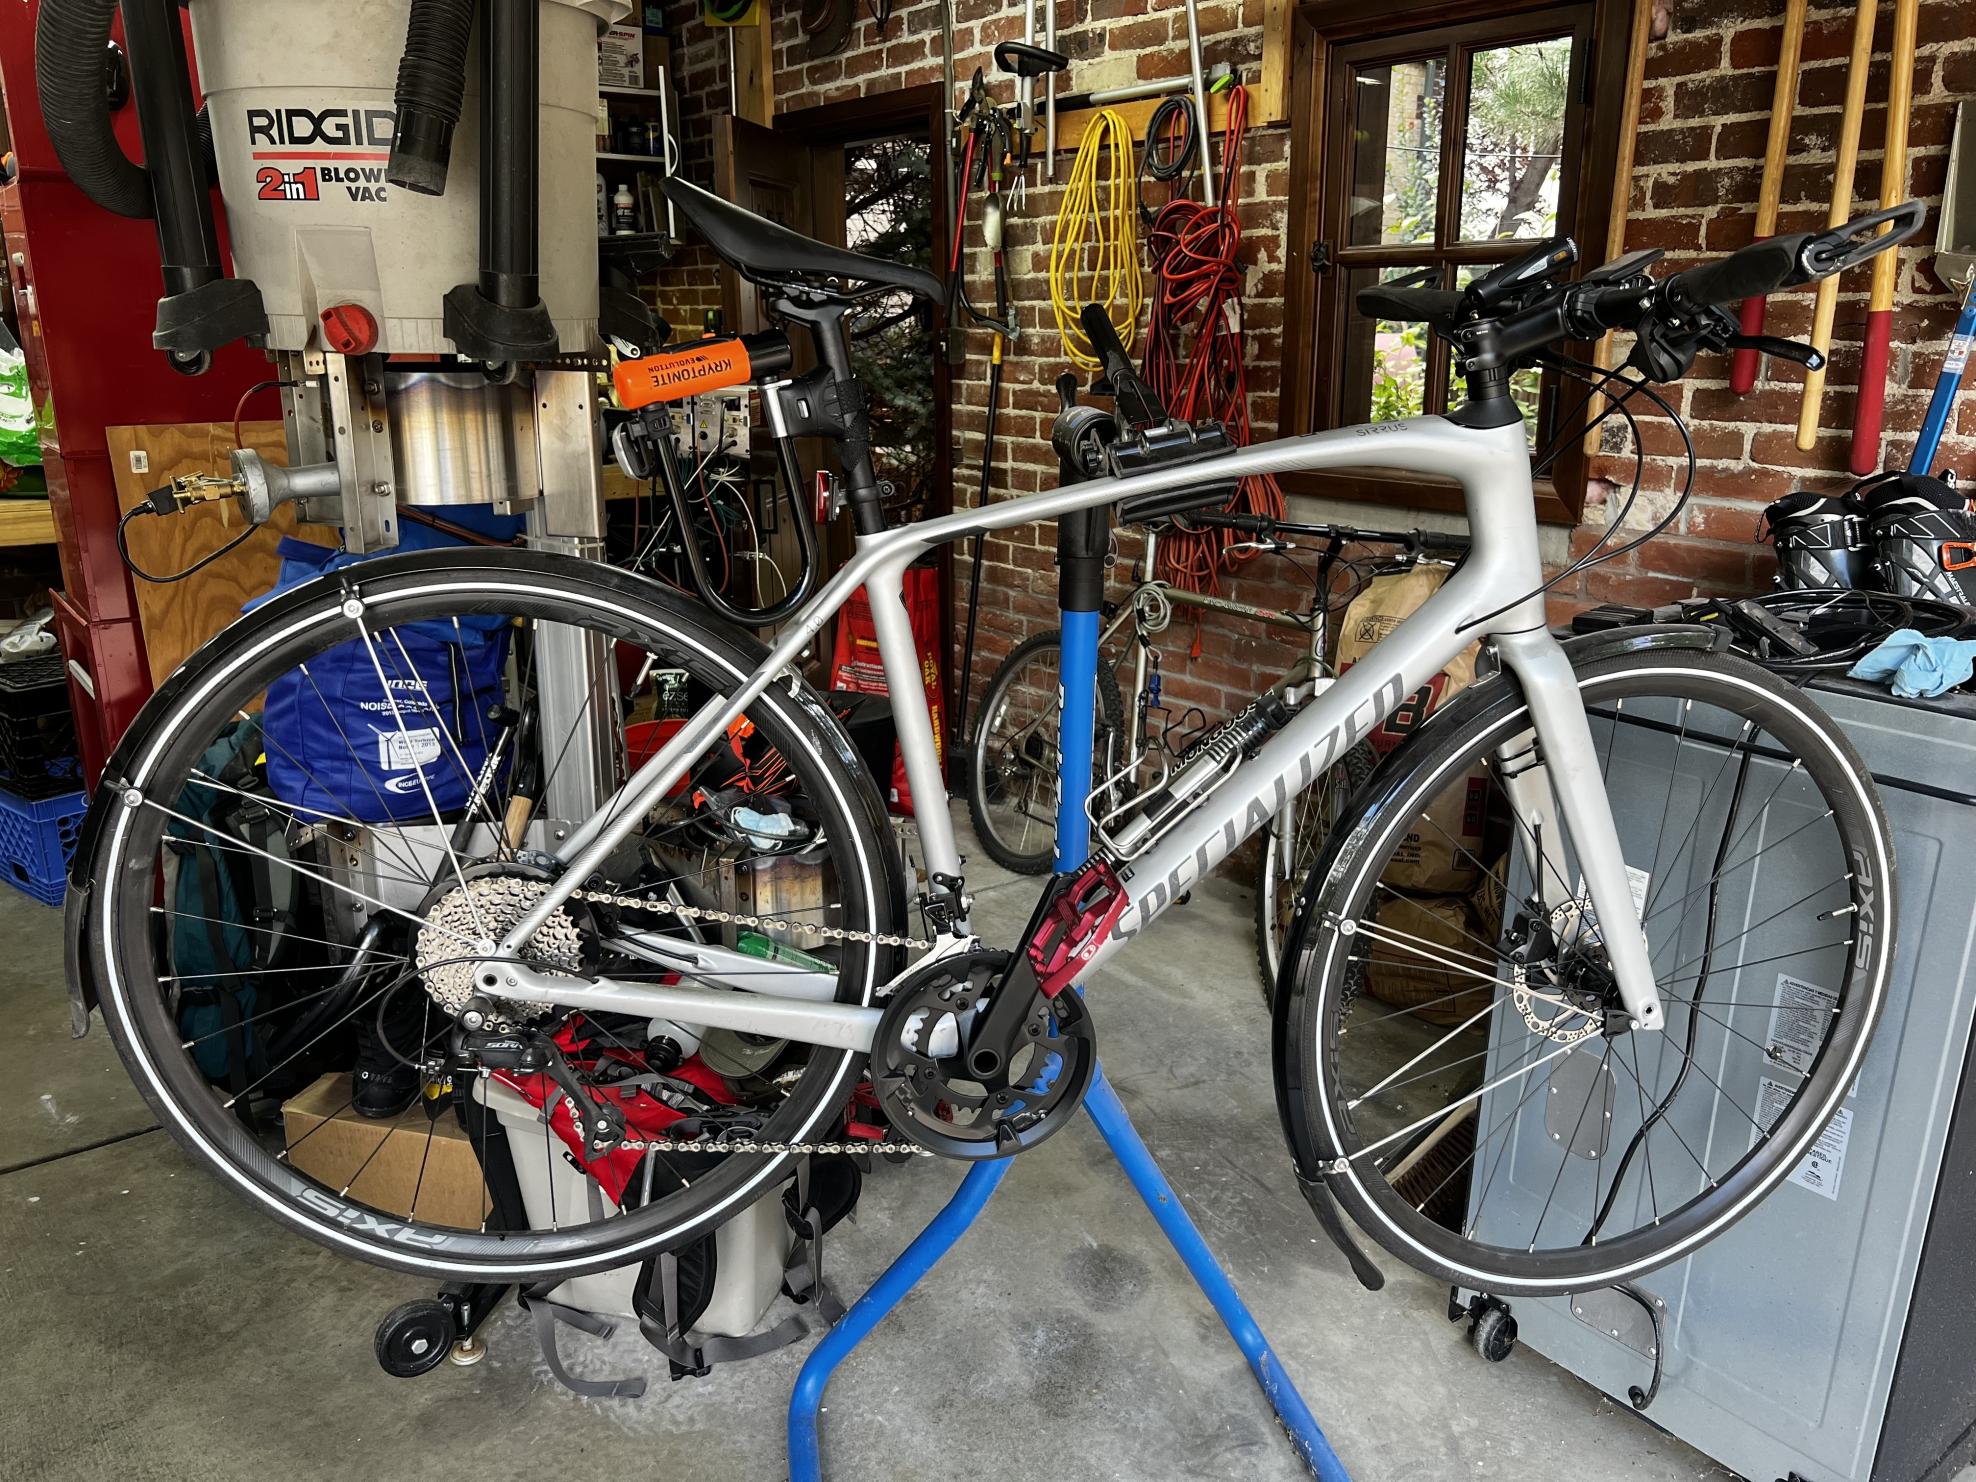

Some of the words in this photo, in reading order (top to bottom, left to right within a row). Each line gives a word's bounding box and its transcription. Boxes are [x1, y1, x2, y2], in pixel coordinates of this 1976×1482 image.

[247, 109, 396, 146] RIDGID
[256, 167, 320, 200] 2in1
[346, 186, 388, 202] VAC
[648, 355, 697, 373] EVOLUTION
[652, 358, 732, 388] KRYPTONITE
[1356, 422, 1408, 437] SIRRUS
